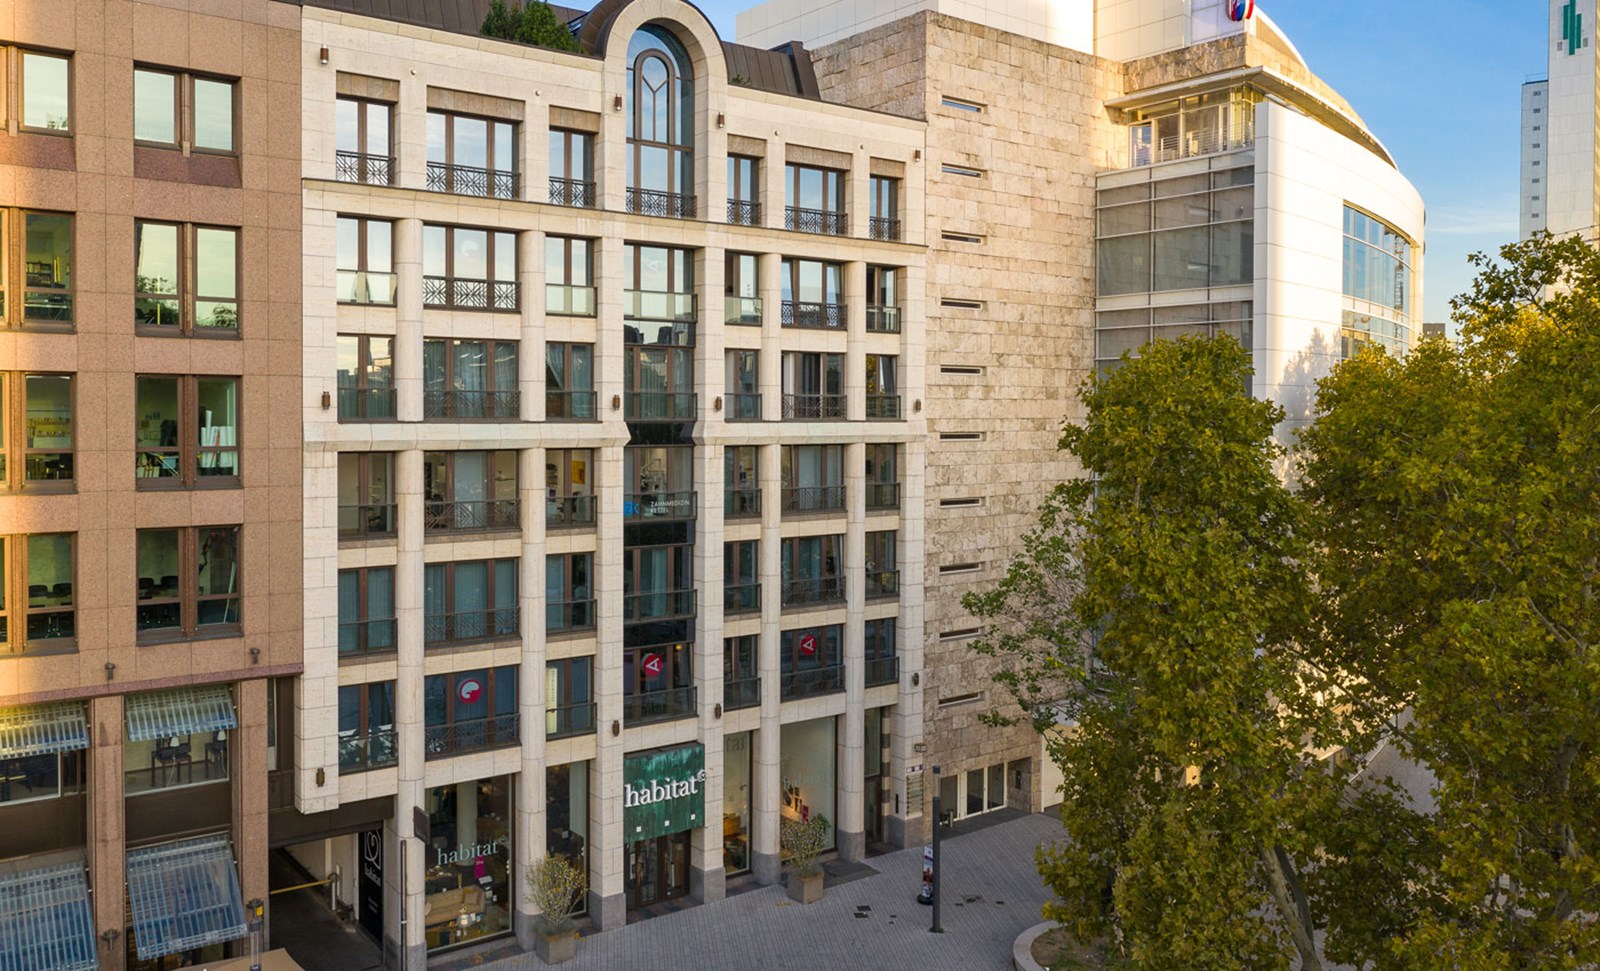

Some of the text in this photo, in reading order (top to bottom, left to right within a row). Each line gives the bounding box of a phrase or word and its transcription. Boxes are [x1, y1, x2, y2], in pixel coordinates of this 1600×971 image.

[650, 499, 690, 508] ZAHNMEDIZIN
[624, 775, 698, 808] habitat
[437, 840, 499, 865] habitat
